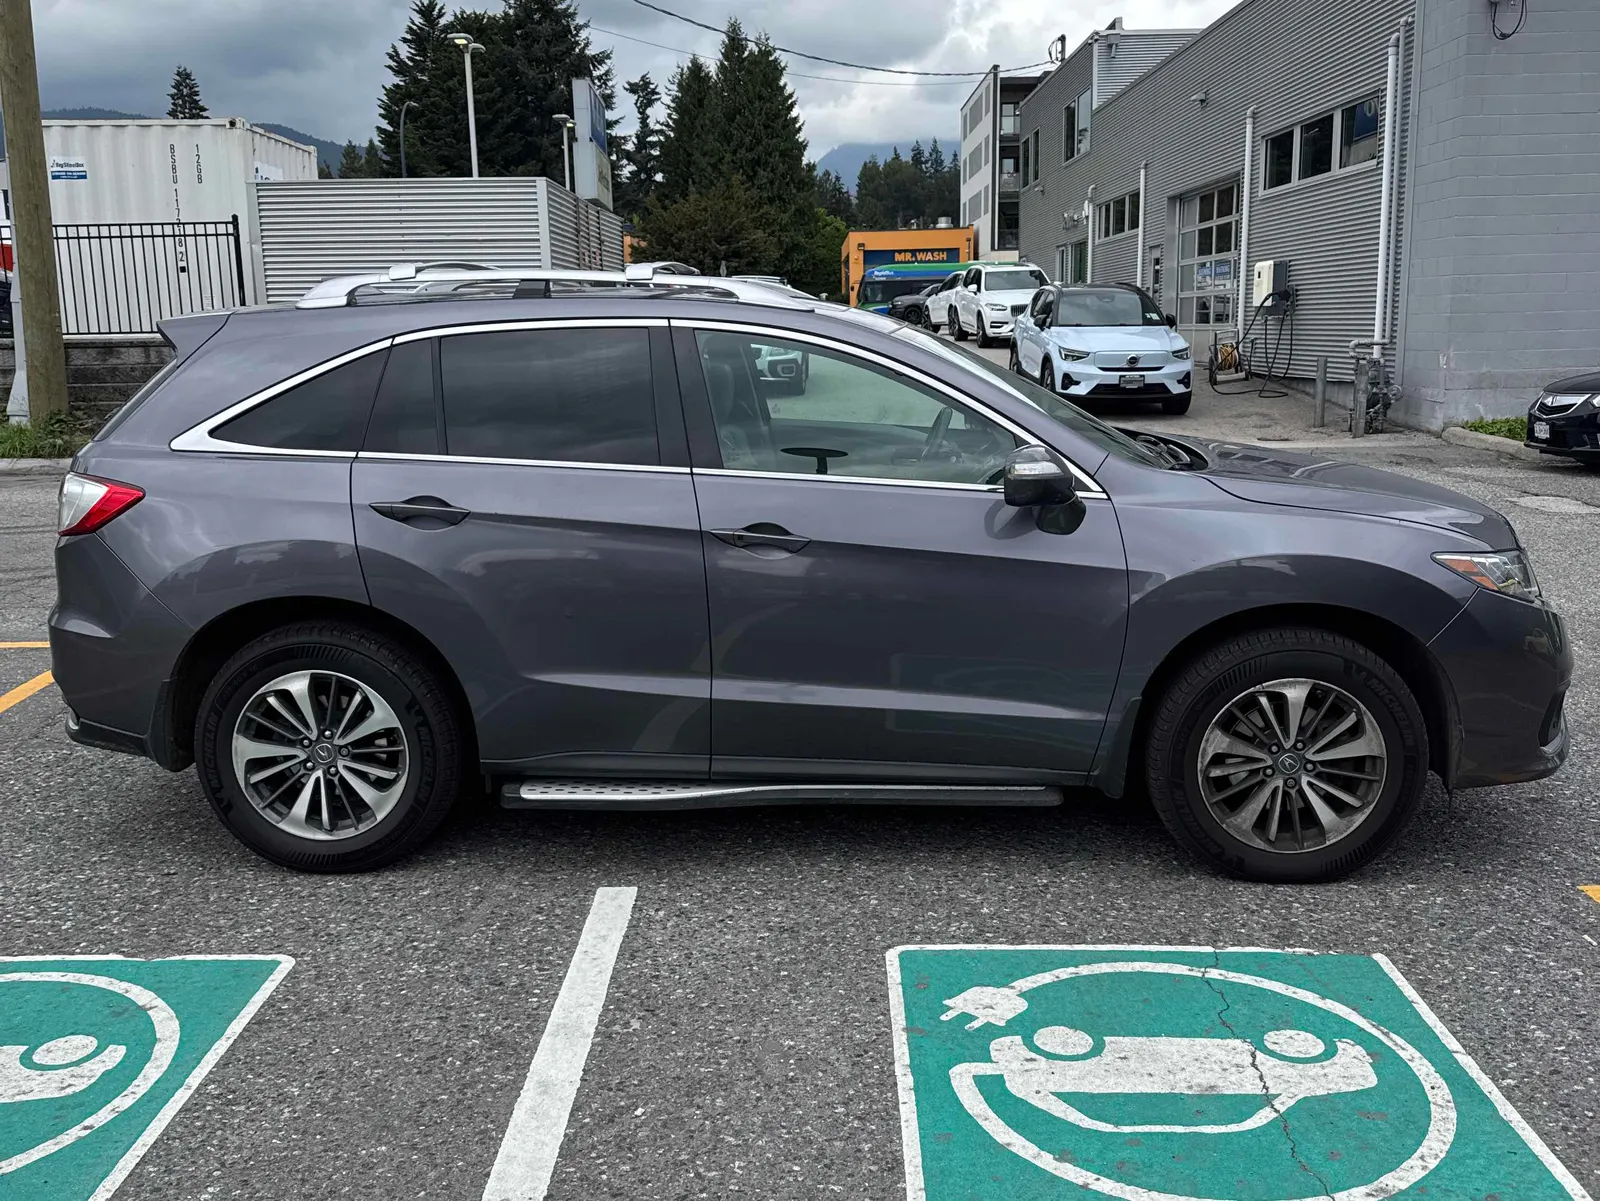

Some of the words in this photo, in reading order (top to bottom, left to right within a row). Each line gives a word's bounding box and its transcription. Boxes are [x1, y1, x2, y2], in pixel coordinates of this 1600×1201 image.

[169, 143, 178, 184] BSBU
[179, 251, 185, 262] 2
[894, 252, 915, 262] MR.
[916, 251, 947, 261] WASH
[1367, 677, 1416, 746] MICHELIN
[203, 711, 223, 788] MICHELIN
